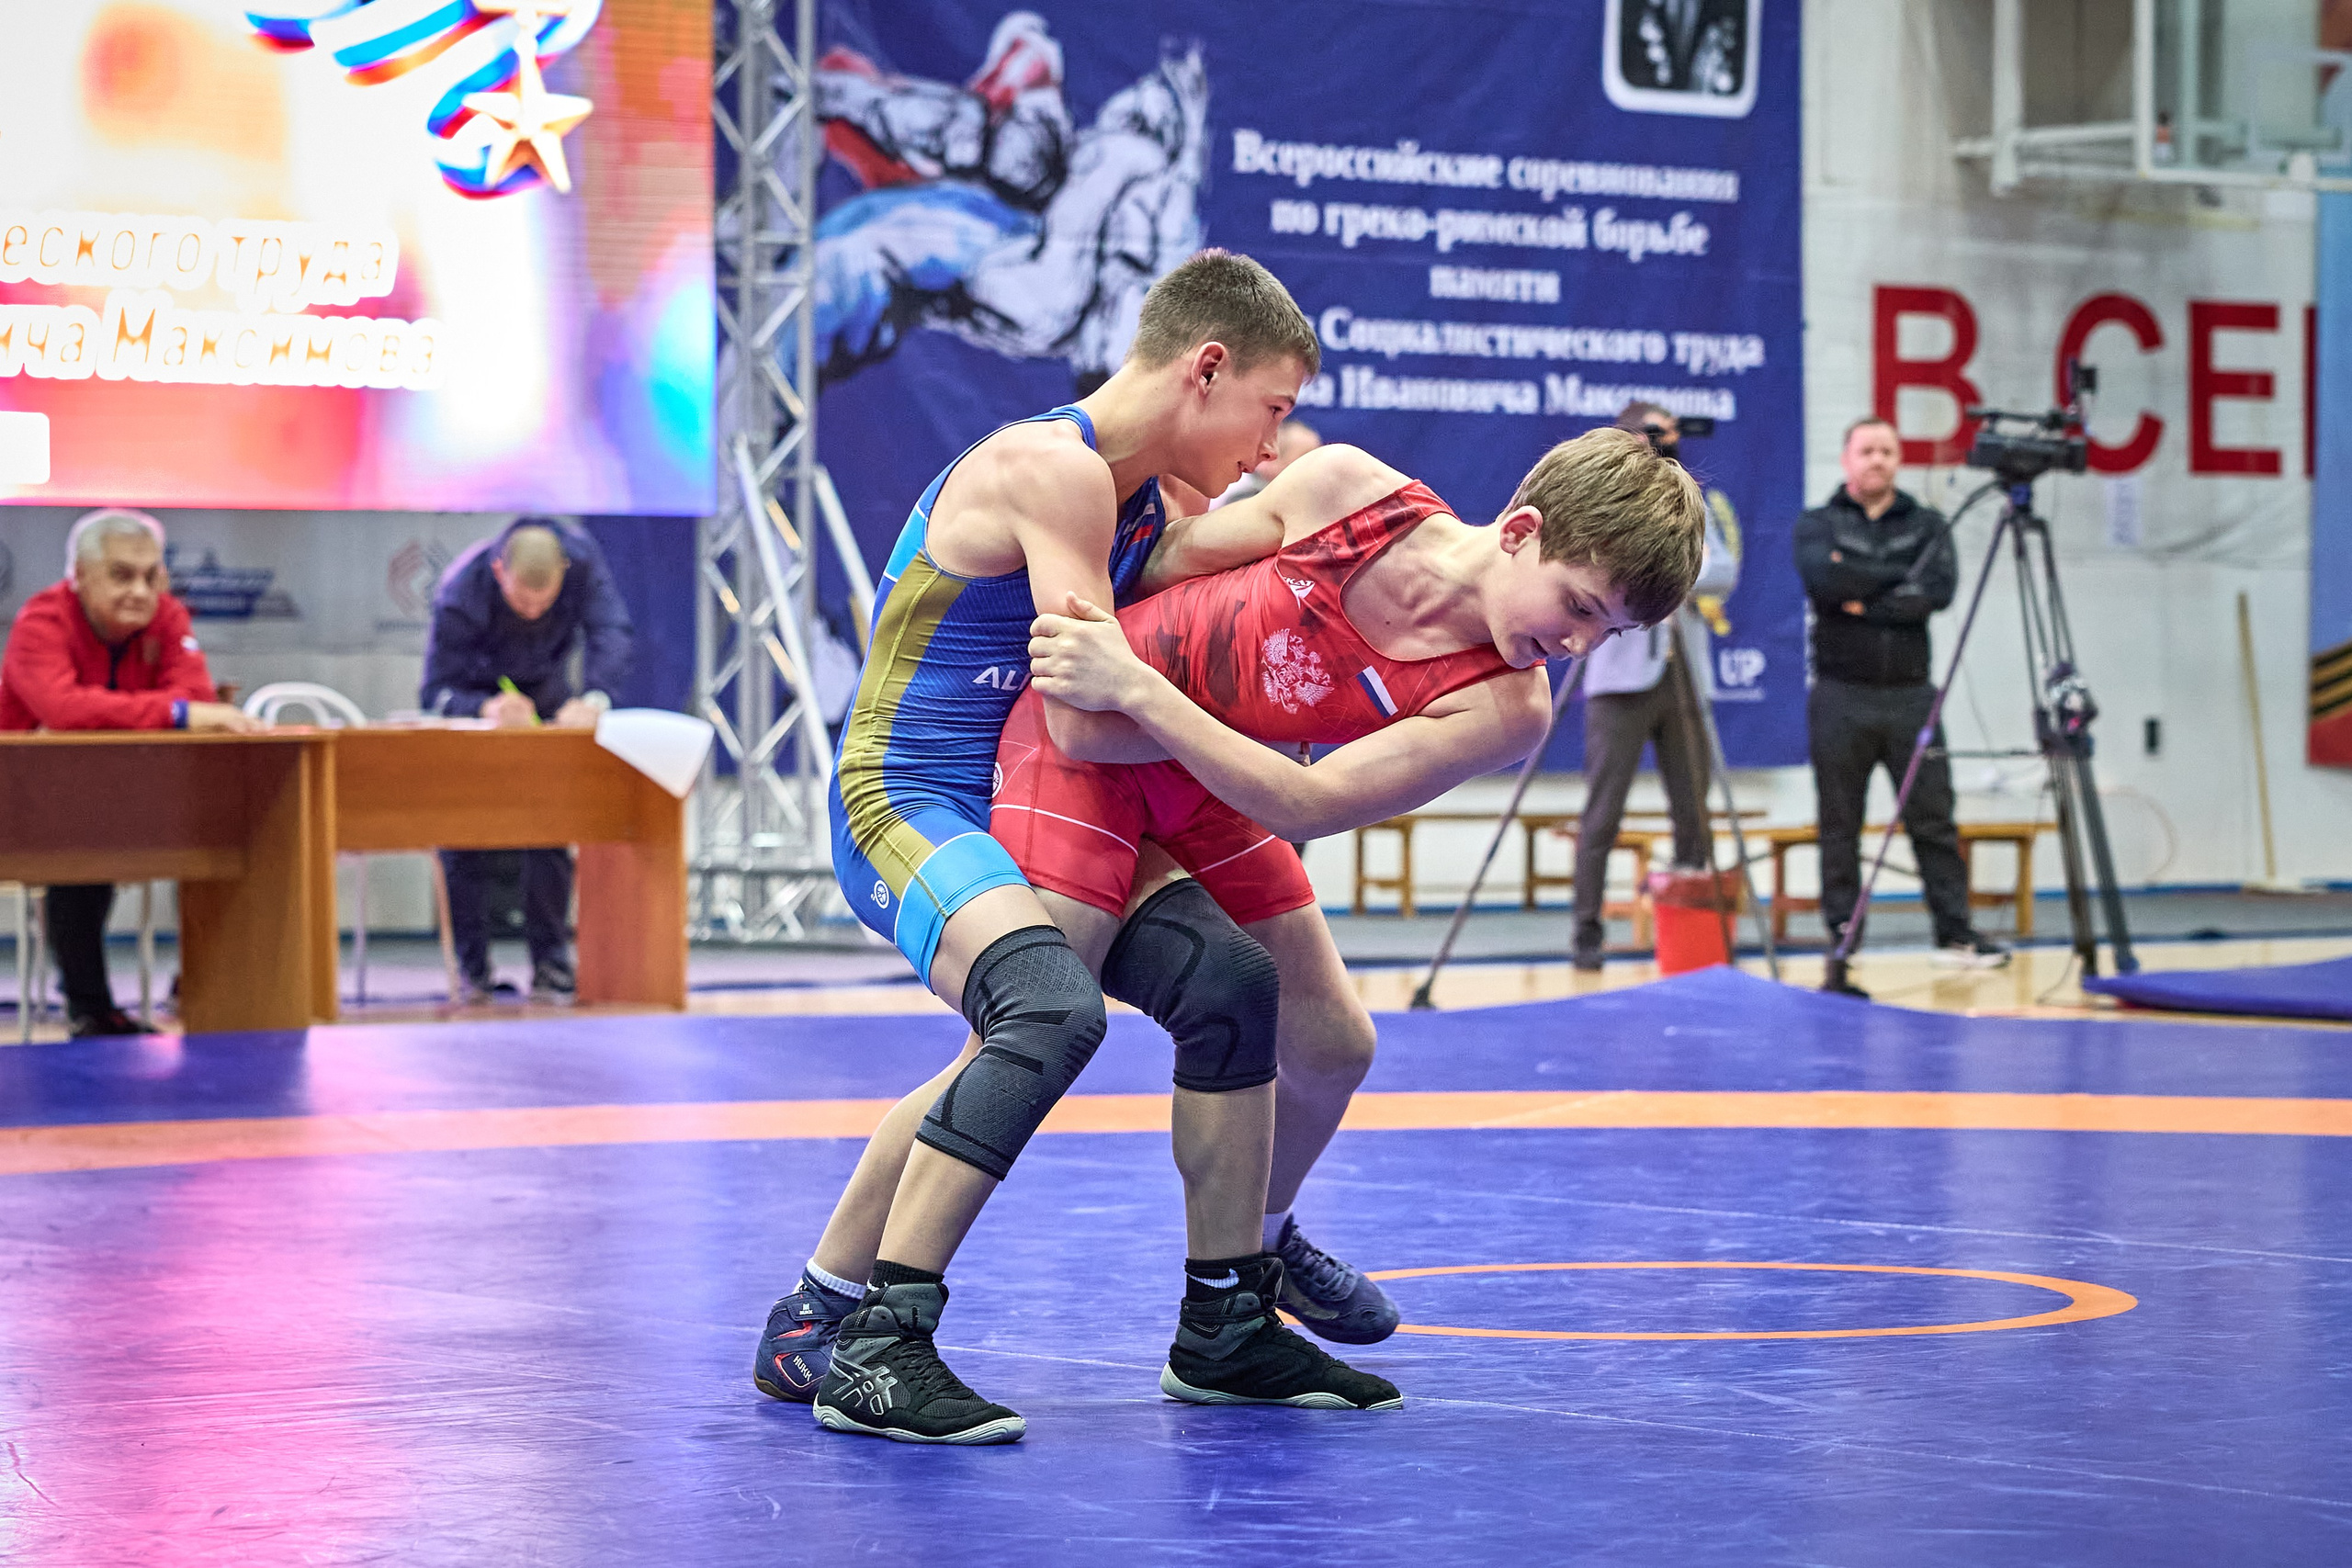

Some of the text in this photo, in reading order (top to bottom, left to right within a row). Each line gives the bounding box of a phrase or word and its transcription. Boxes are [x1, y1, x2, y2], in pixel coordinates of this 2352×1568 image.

[1232, 128, 1740, 203] Всероссийские соревнования
[1270, 198, 1710, 263] по греко-римской борьбе
[230, 234, 385, 298] труда
[1430, 265, 1560, 304] памяти
[112, 305, 435, 375] Максимова
[1319, 306, 1766, 377] Социалистического труда
[1339, 365, 1540, 414] Ивановича
[1544, 372, 1737, 423] Максимова
